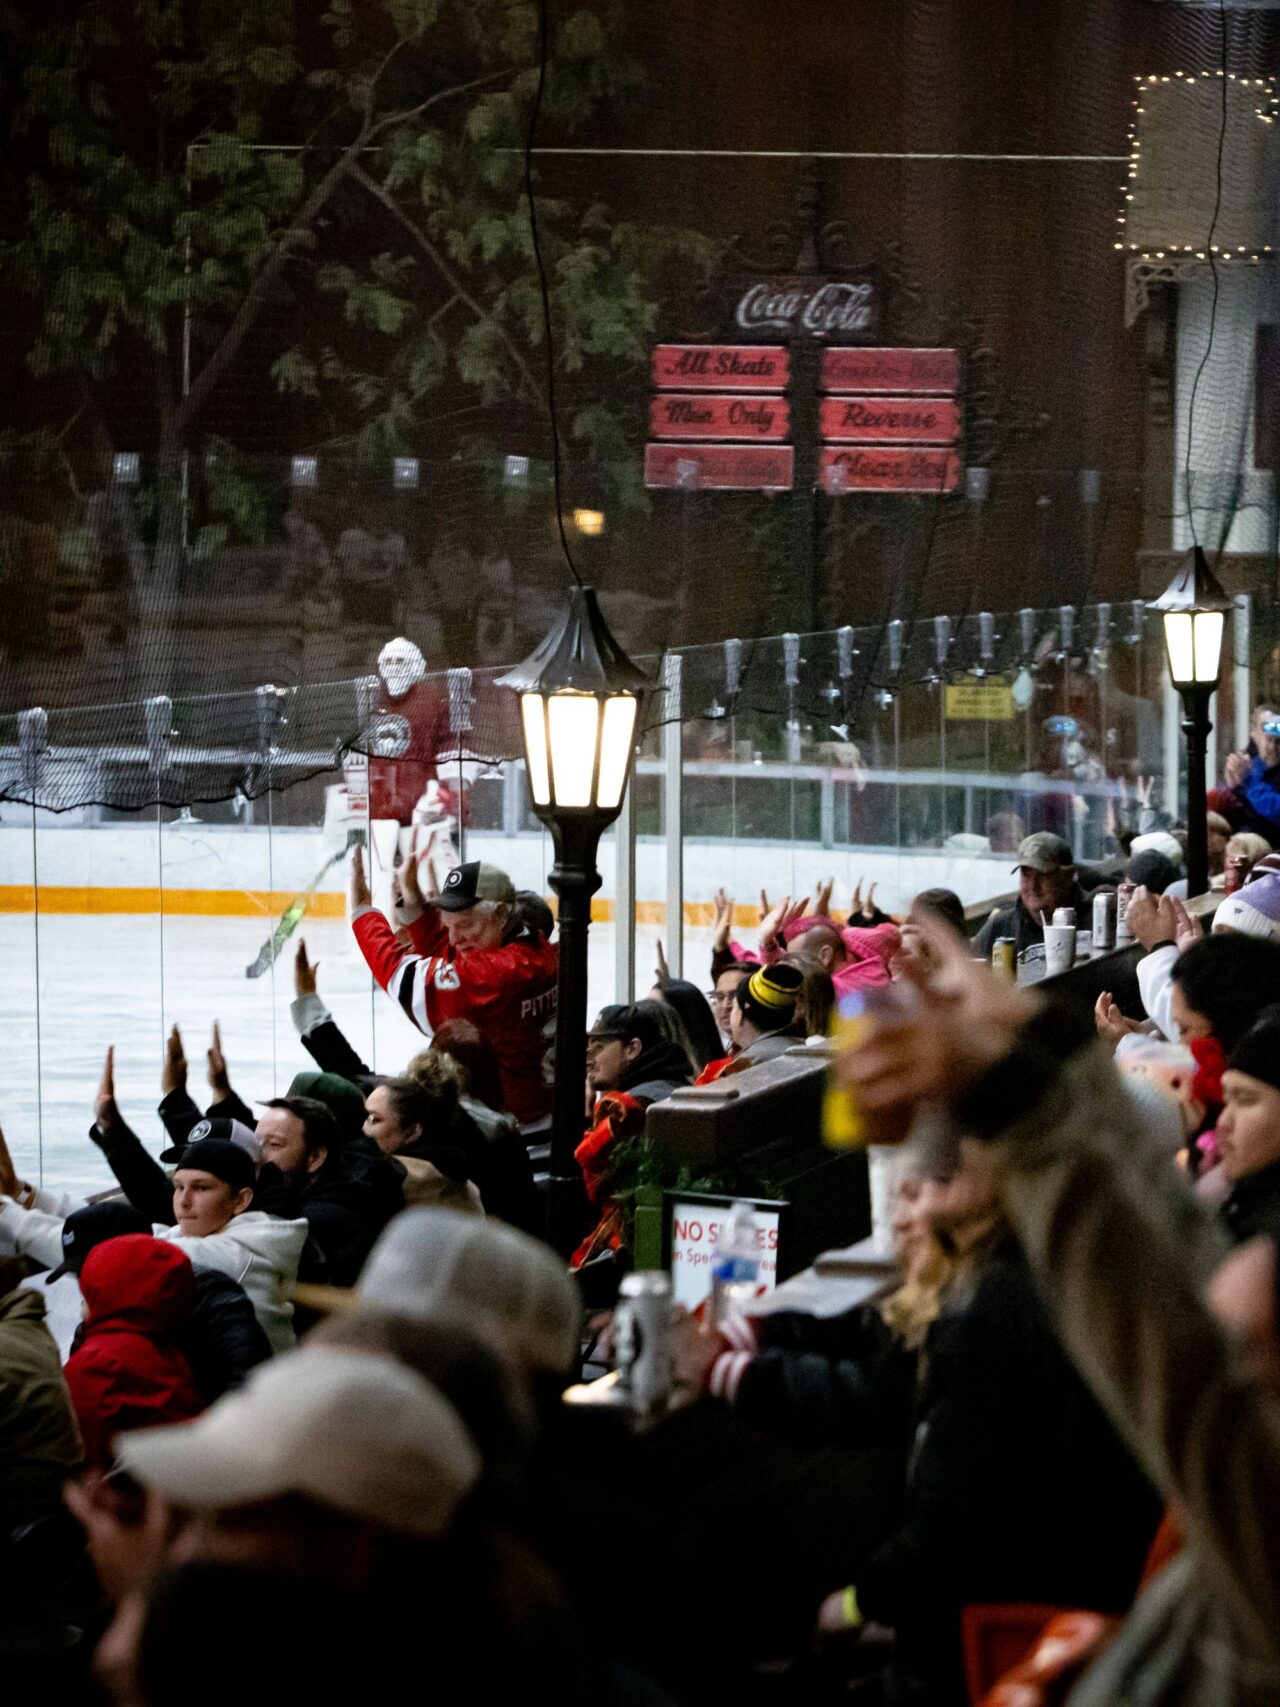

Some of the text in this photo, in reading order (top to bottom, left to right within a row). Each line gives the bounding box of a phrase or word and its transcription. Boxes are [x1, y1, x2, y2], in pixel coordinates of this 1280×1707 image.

[736, 283, 872, 330] Coca-Cola
[664, 351, 775, 376] All Skate
[728, 401, 775, 433] Only
[841, 403, 937, 429] Reverse
[674, 1219, 778, 1249] NO SES
